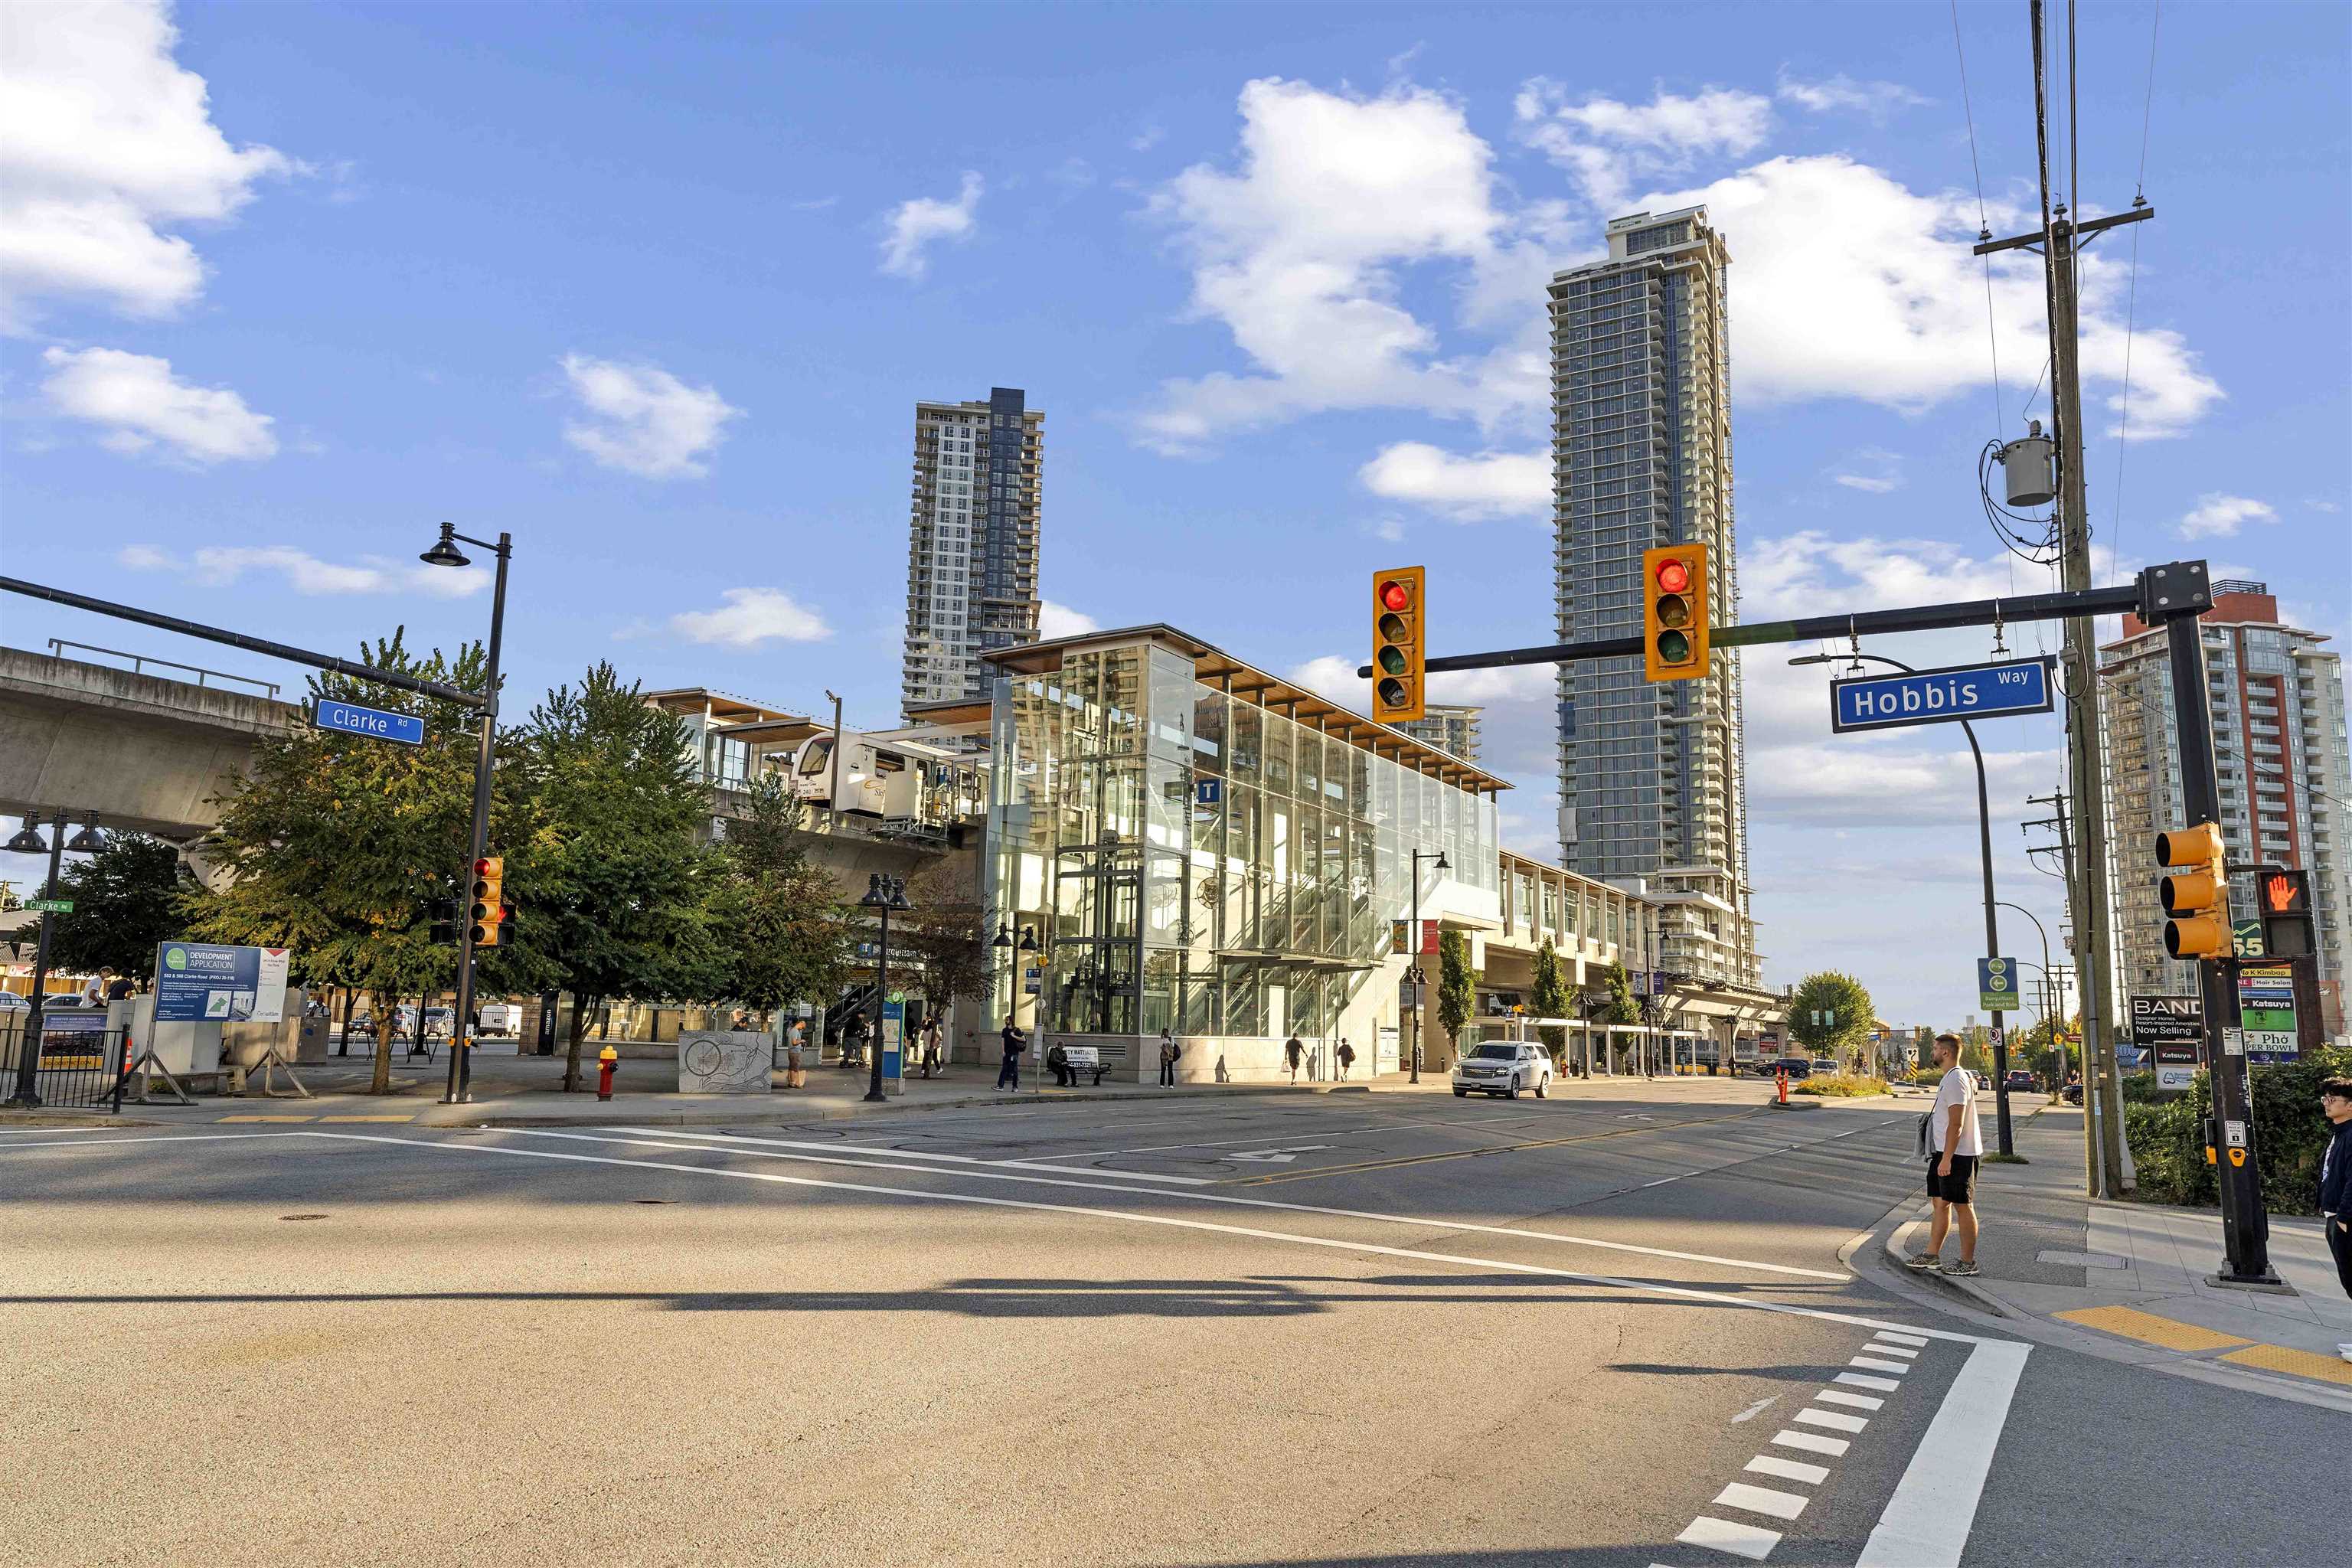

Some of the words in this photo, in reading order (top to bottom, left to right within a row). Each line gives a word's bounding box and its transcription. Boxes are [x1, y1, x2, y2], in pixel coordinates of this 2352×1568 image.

[1854, 679, 1978, 717] Hobbis
[1998, 671, 2029, 685] Way
[333, 708, 387, 733] Clarke
[397, 717, 408, 727] Rd
[1203, 782, 1215, 799] T
[30, 900, 58, 911] Clarke
[190, 952, 234, 961] DEVELOPMENT
[189, 959, 233, 969] APPLICATION
[2252, 1000, 2292, 1009] Katsuya
[2159, 1026, 2192, 1036] Selling
[2161, 1052, 2192, 1060] Katsuya
